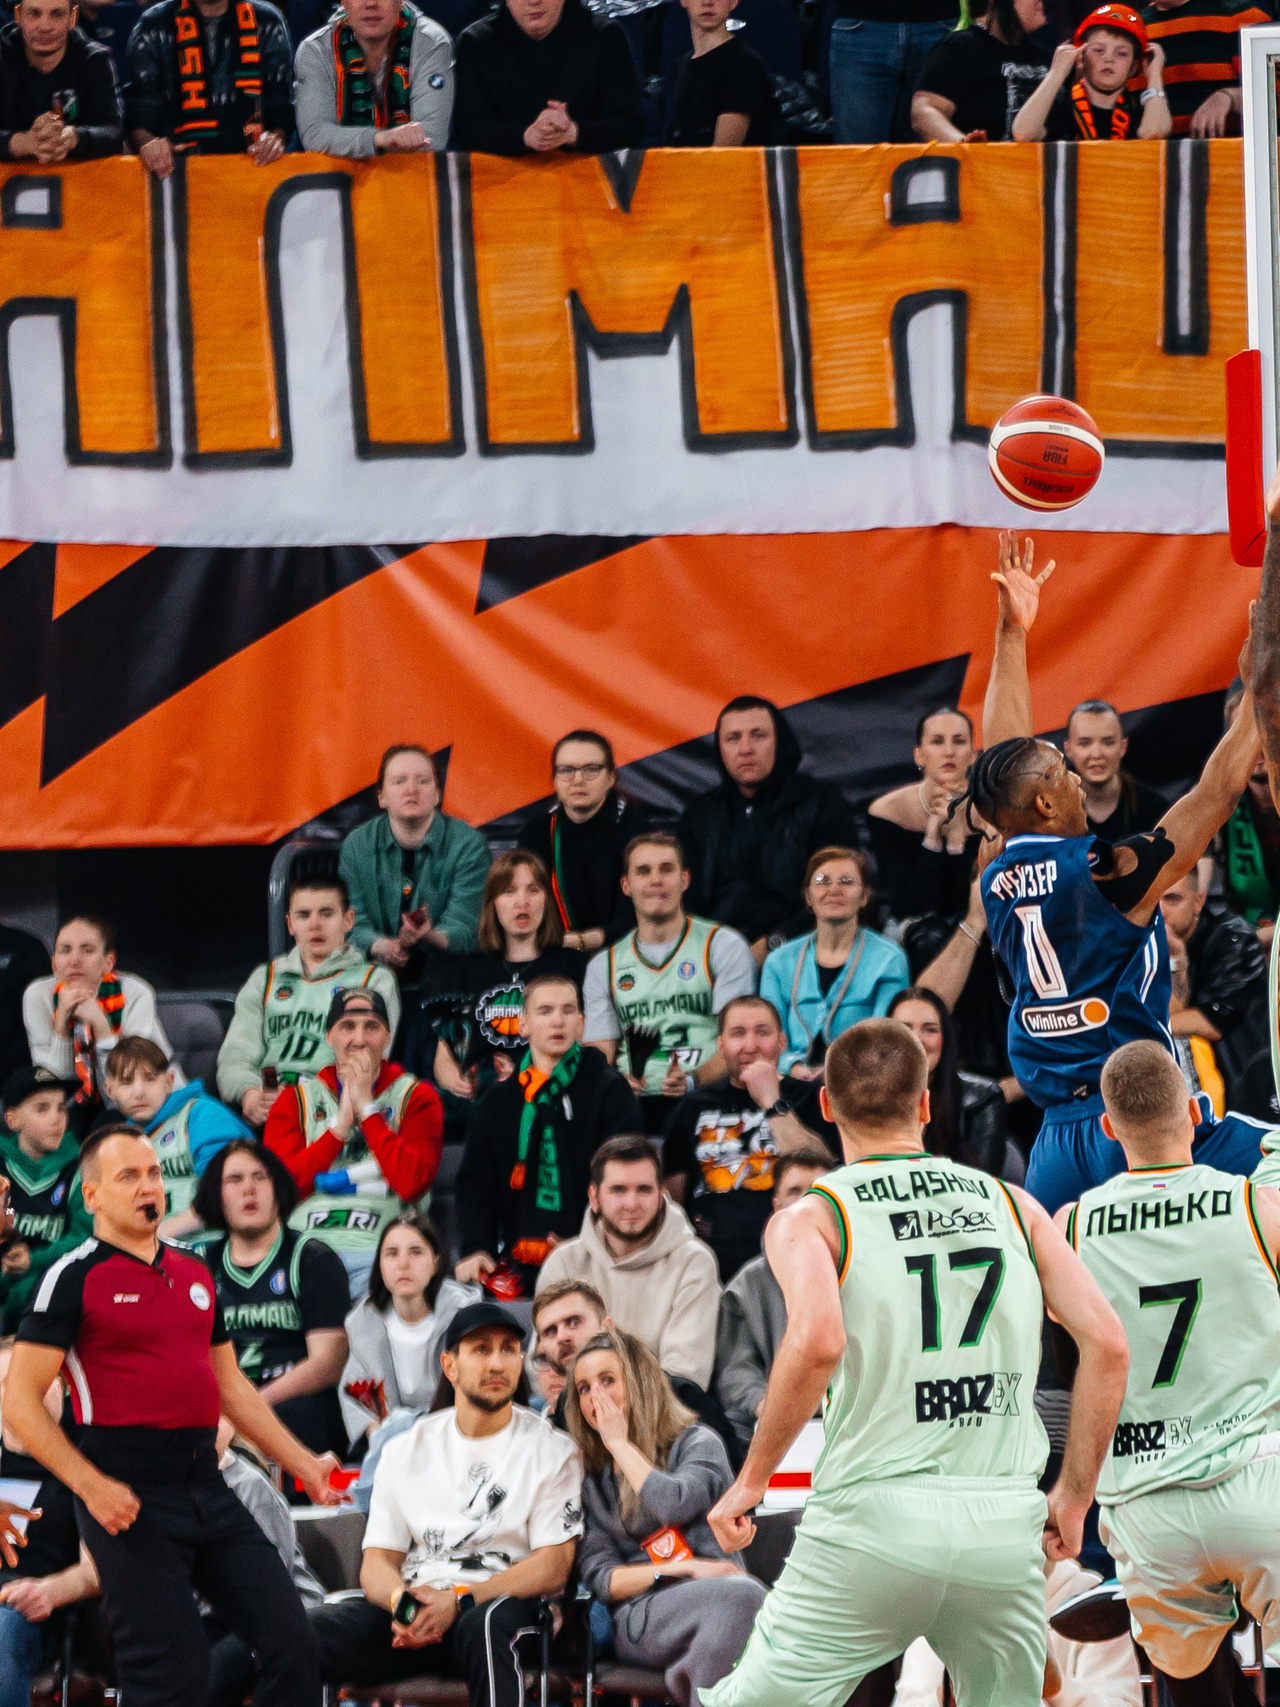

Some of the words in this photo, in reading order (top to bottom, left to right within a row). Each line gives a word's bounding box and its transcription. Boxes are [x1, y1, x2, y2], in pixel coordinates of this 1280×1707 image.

[1014, 904, 1069, 1000] 0
[485, 1006, 522, 1022] УРАЛМ
[1027, 1011, 1079, 1032] Winline
[853, 1170, 991, 1202] BALASHOV
[924, 1205, 996, 1231] Робек
[904, 1248, 1006, 1353] 17
[1138, 1278, 1203, 1389] 7
[914, 1371, 1022, 1423] BROZEX
